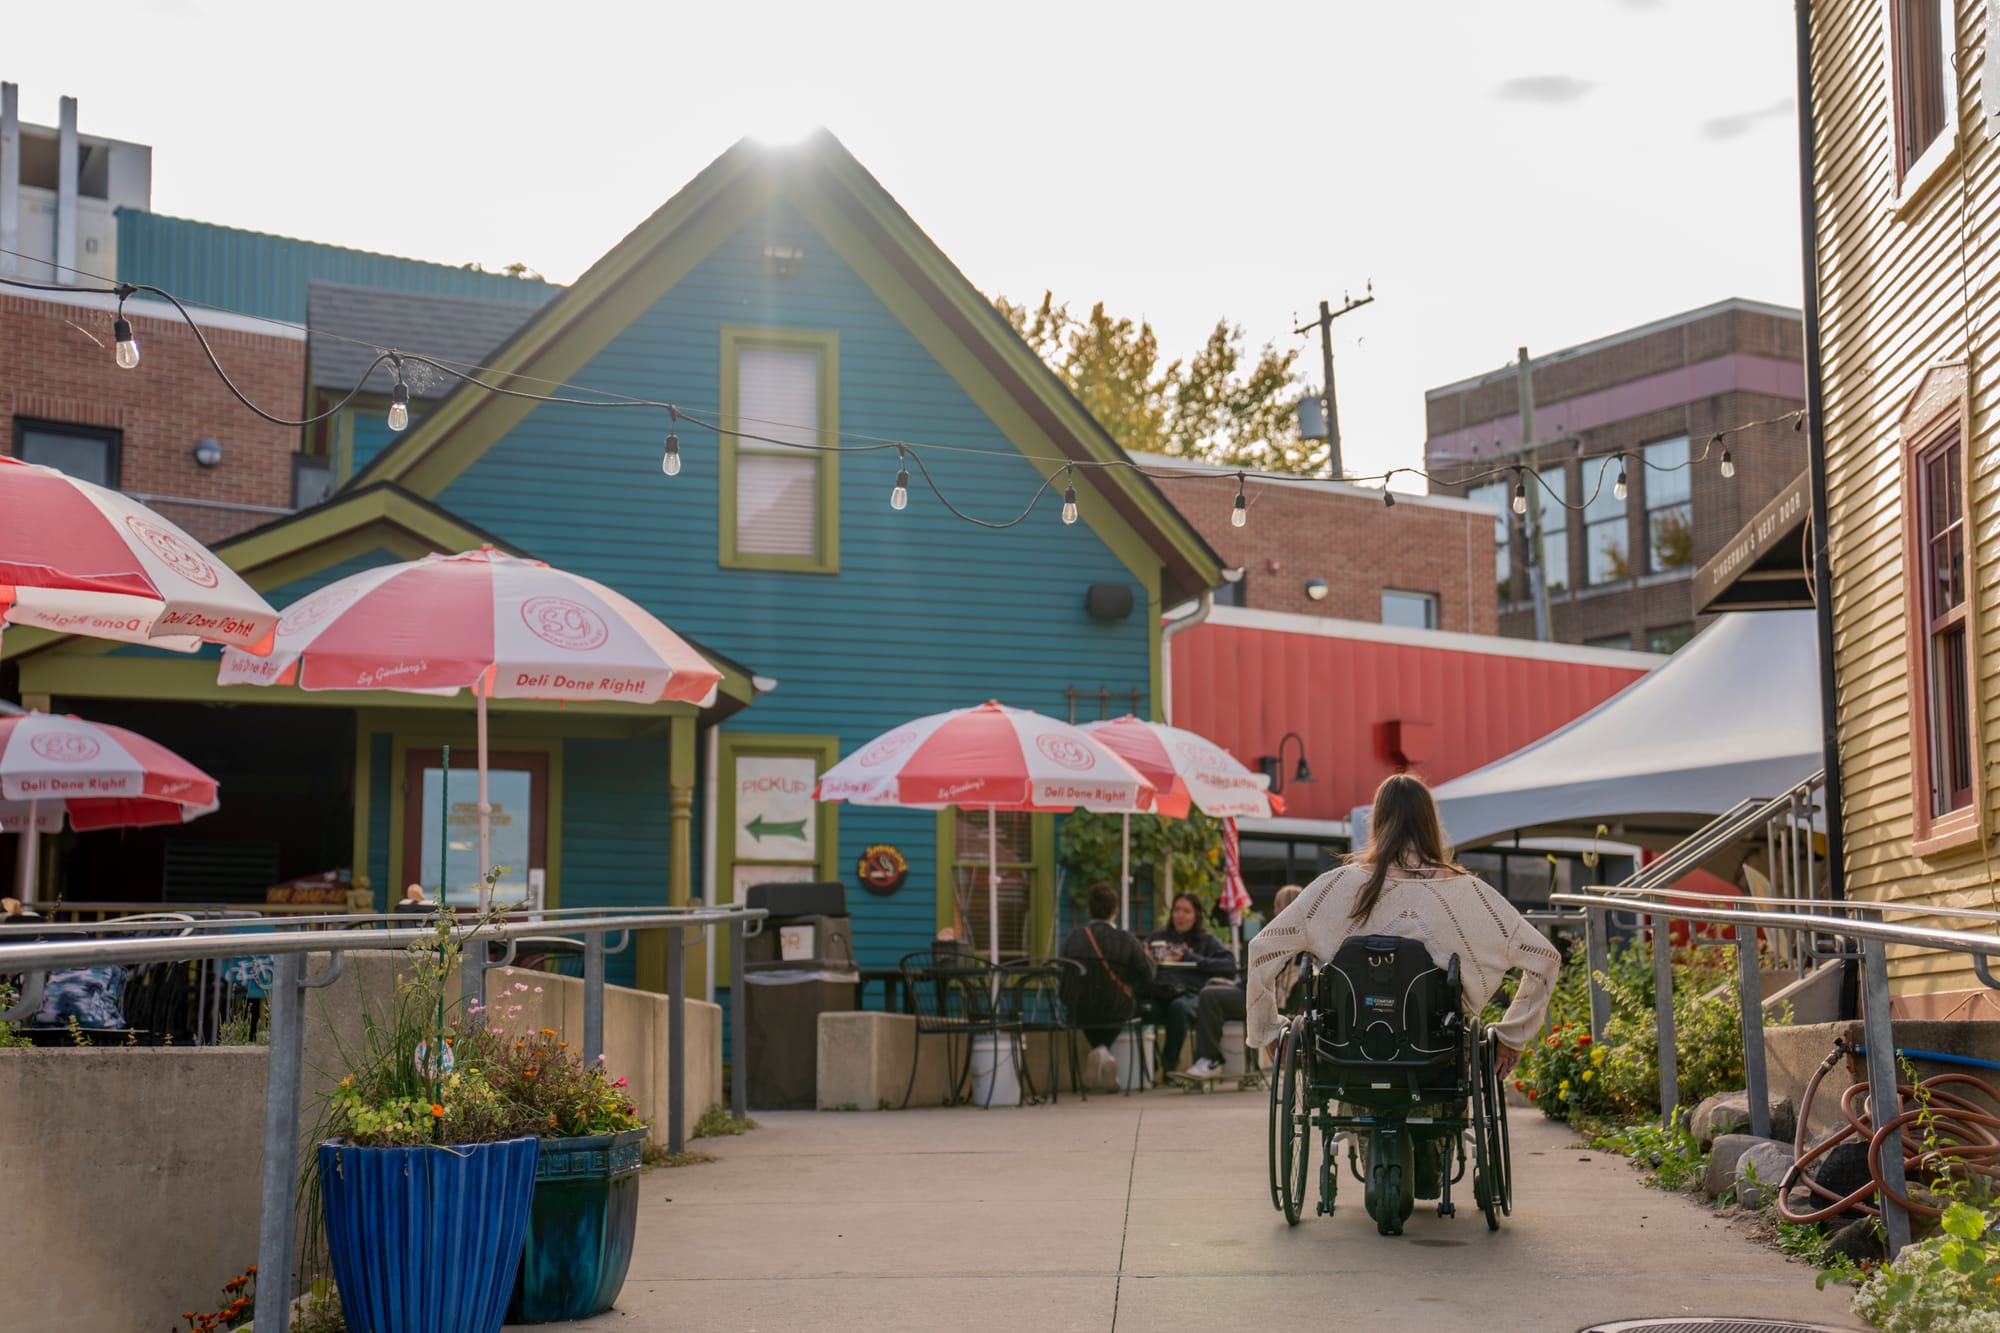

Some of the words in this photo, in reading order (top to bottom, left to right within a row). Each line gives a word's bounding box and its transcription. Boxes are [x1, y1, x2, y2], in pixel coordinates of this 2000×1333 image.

[1712, 533, 1754, 585] ZINGERMAN'S
[1758, 514, 1775, 543] NEXT
[1780, 491, 1801, 523] DOOR
[516, 673, 550, 687] Deli
[553, 675, 594, 690] Done
[599, 678, 646, 694] Right!
[20, 779, 47, 792] Deli
[52, 779, 85, 790] Done
[89, 778, 127, 791] Right!
[742, 776, 808, 796] PICKUP
[1044, 786, 1066, 798] Deli
[1066, 786, 1093, 799] Done
[1095, 788, 1127, 804] Right!
